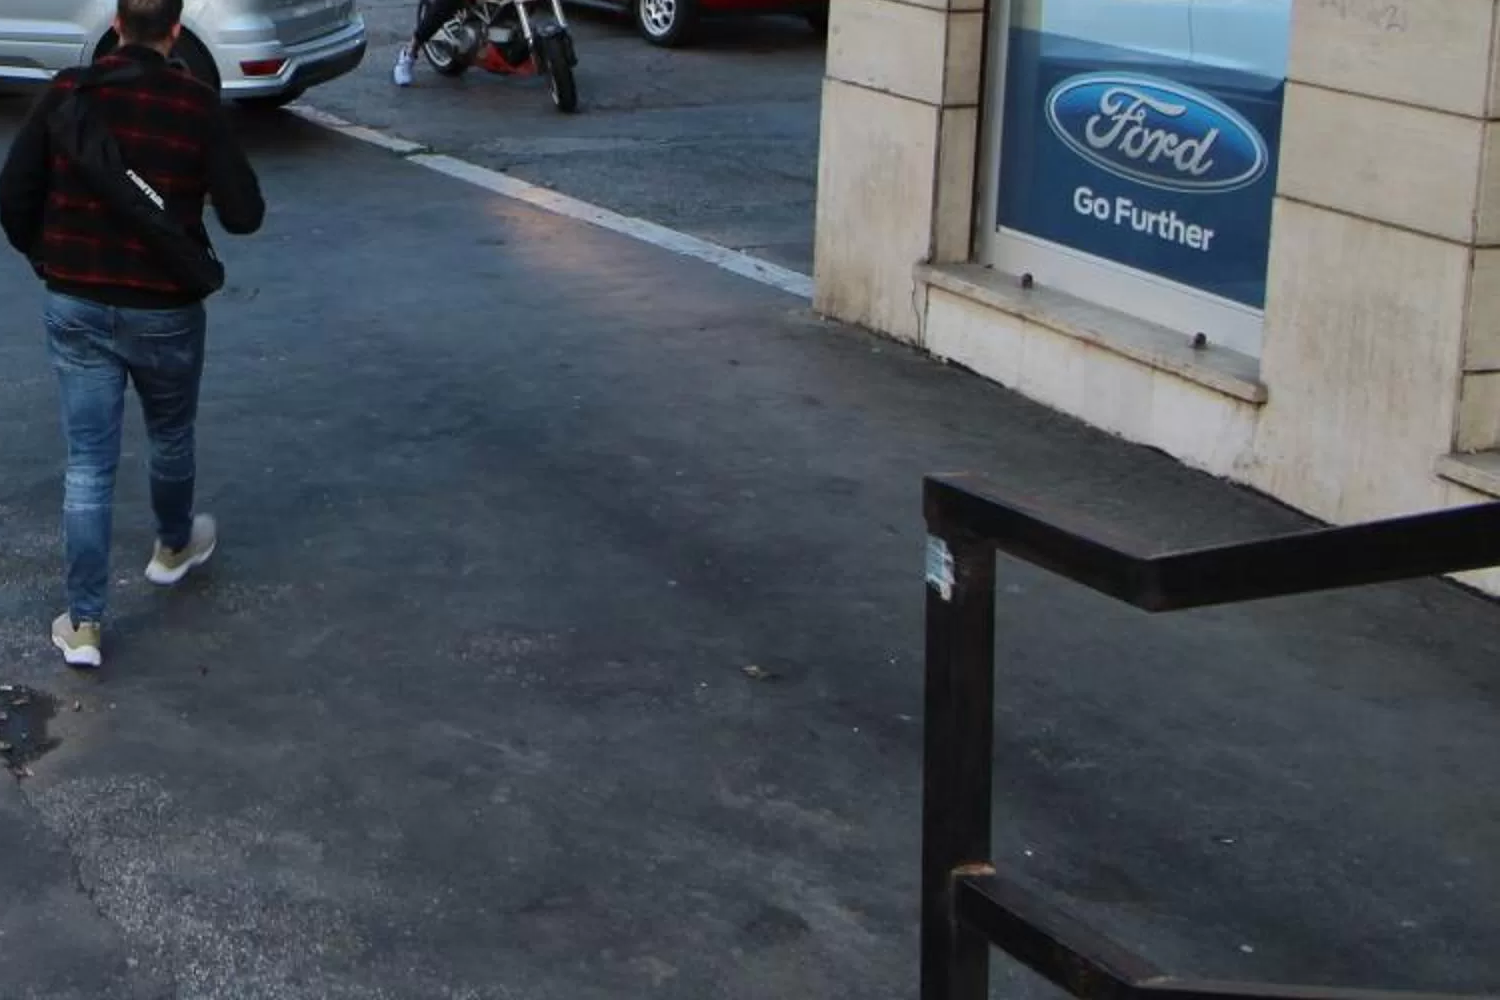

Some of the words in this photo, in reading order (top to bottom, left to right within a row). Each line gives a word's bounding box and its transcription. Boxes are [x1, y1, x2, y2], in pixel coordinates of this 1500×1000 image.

[1086, 87, 1219, 176] Ford
[1073, 186, 1110, 221] Go
[1114, 197, 1214, 252] Further
